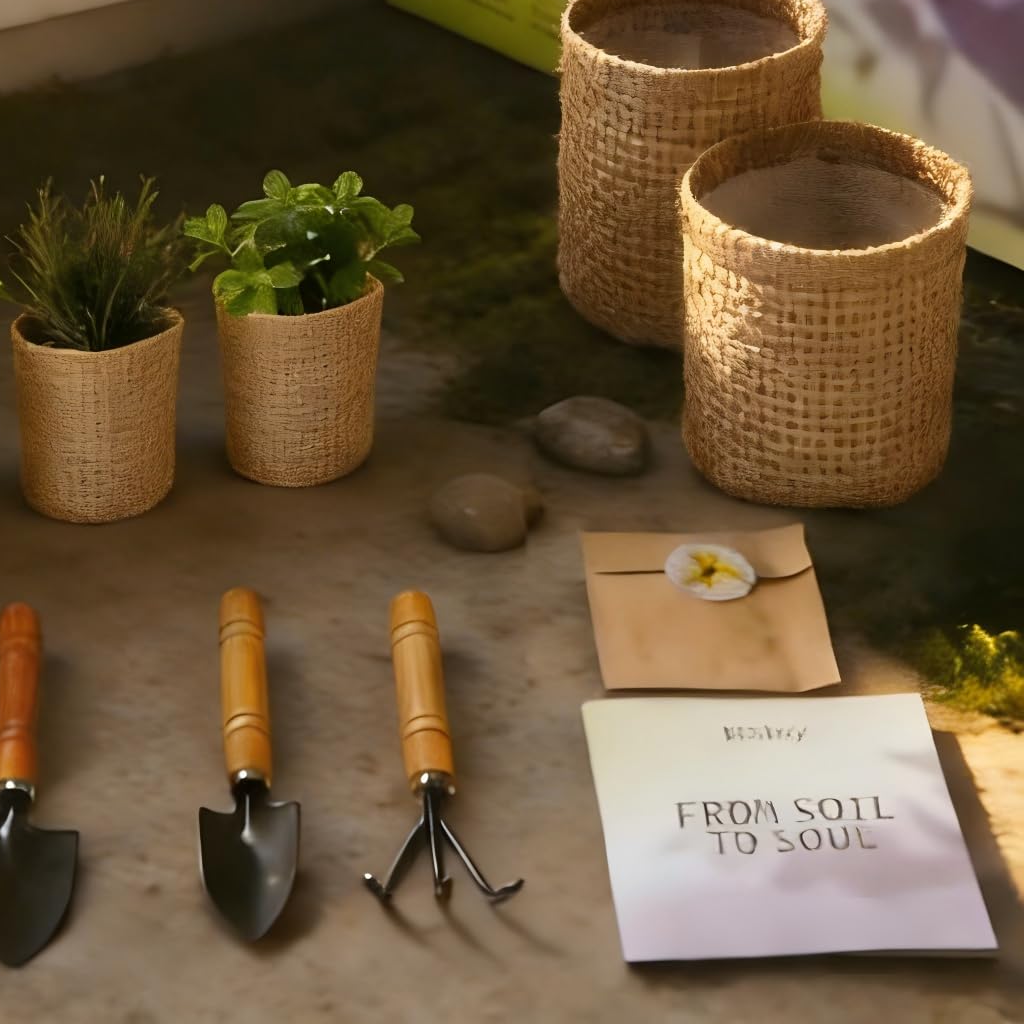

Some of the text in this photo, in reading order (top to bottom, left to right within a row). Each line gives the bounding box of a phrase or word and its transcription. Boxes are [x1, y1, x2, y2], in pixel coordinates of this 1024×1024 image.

[675, 795, 895, 828] FROM SOIL
[706, 825, 878, 855] TO SOUL
